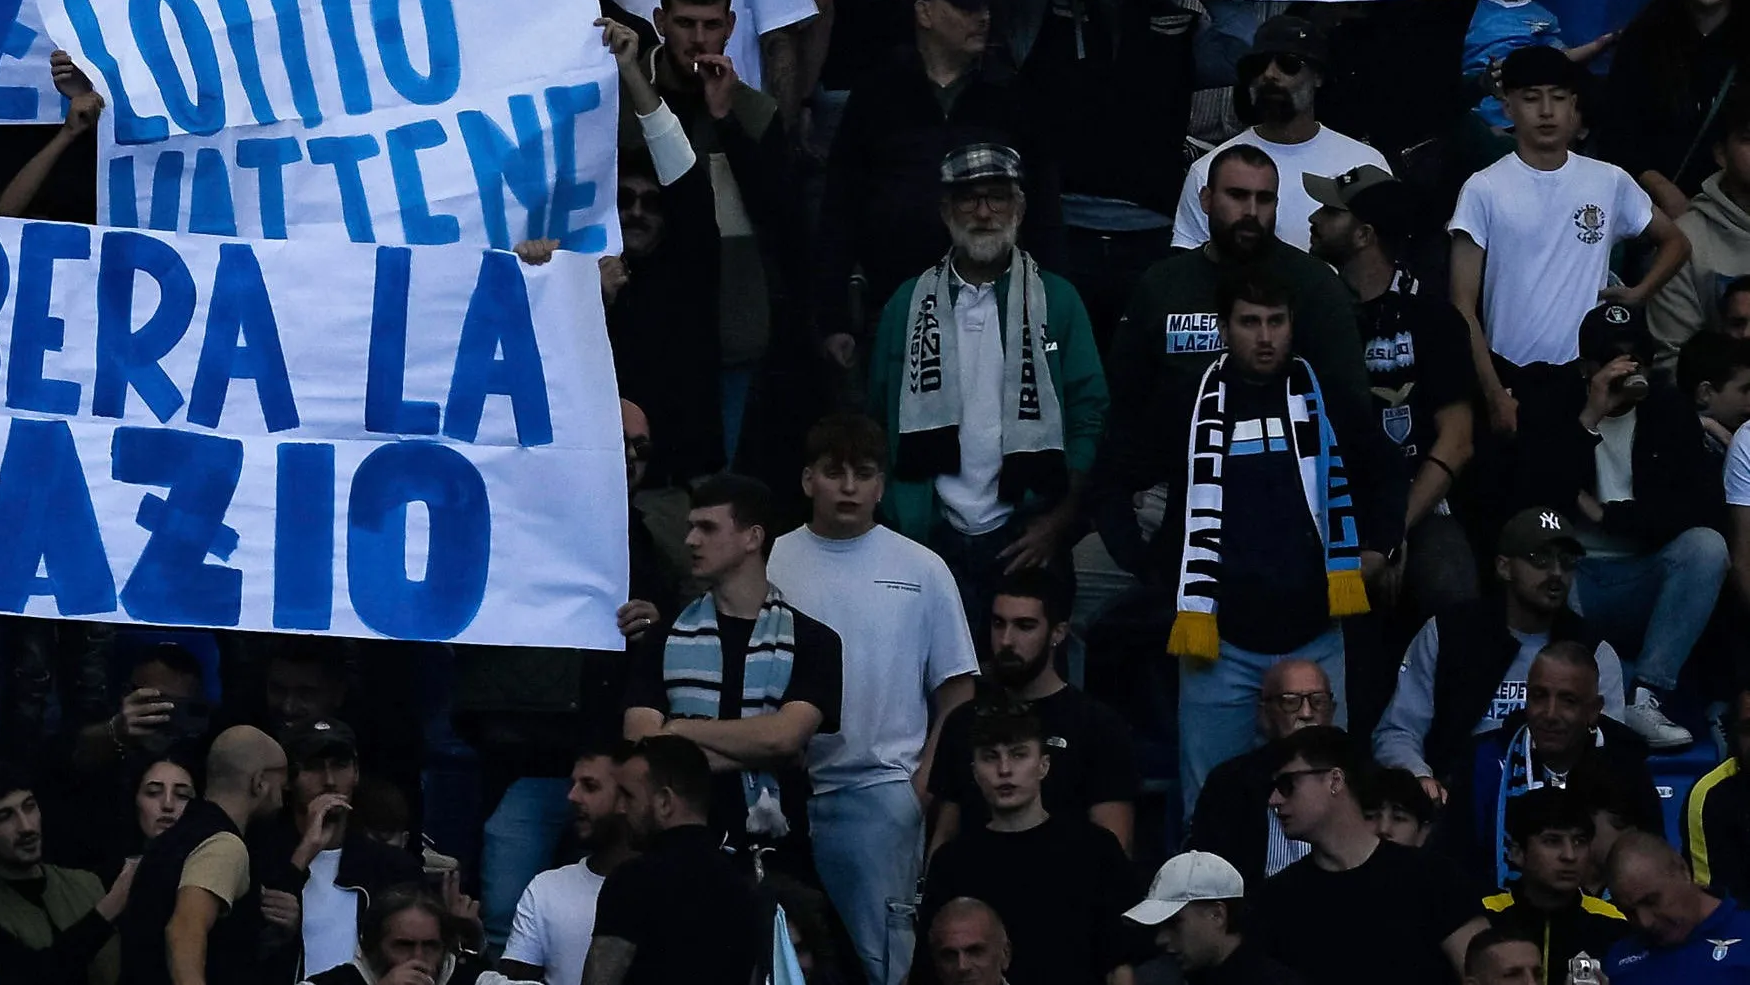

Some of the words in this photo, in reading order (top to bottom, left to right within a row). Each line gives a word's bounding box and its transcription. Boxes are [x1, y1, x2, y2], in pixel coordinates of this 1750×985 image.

[108, 82, 607, 253] VATTENE
[365, 245, 554, 447] LA
[1170, 315, 1218, 332] MALED
